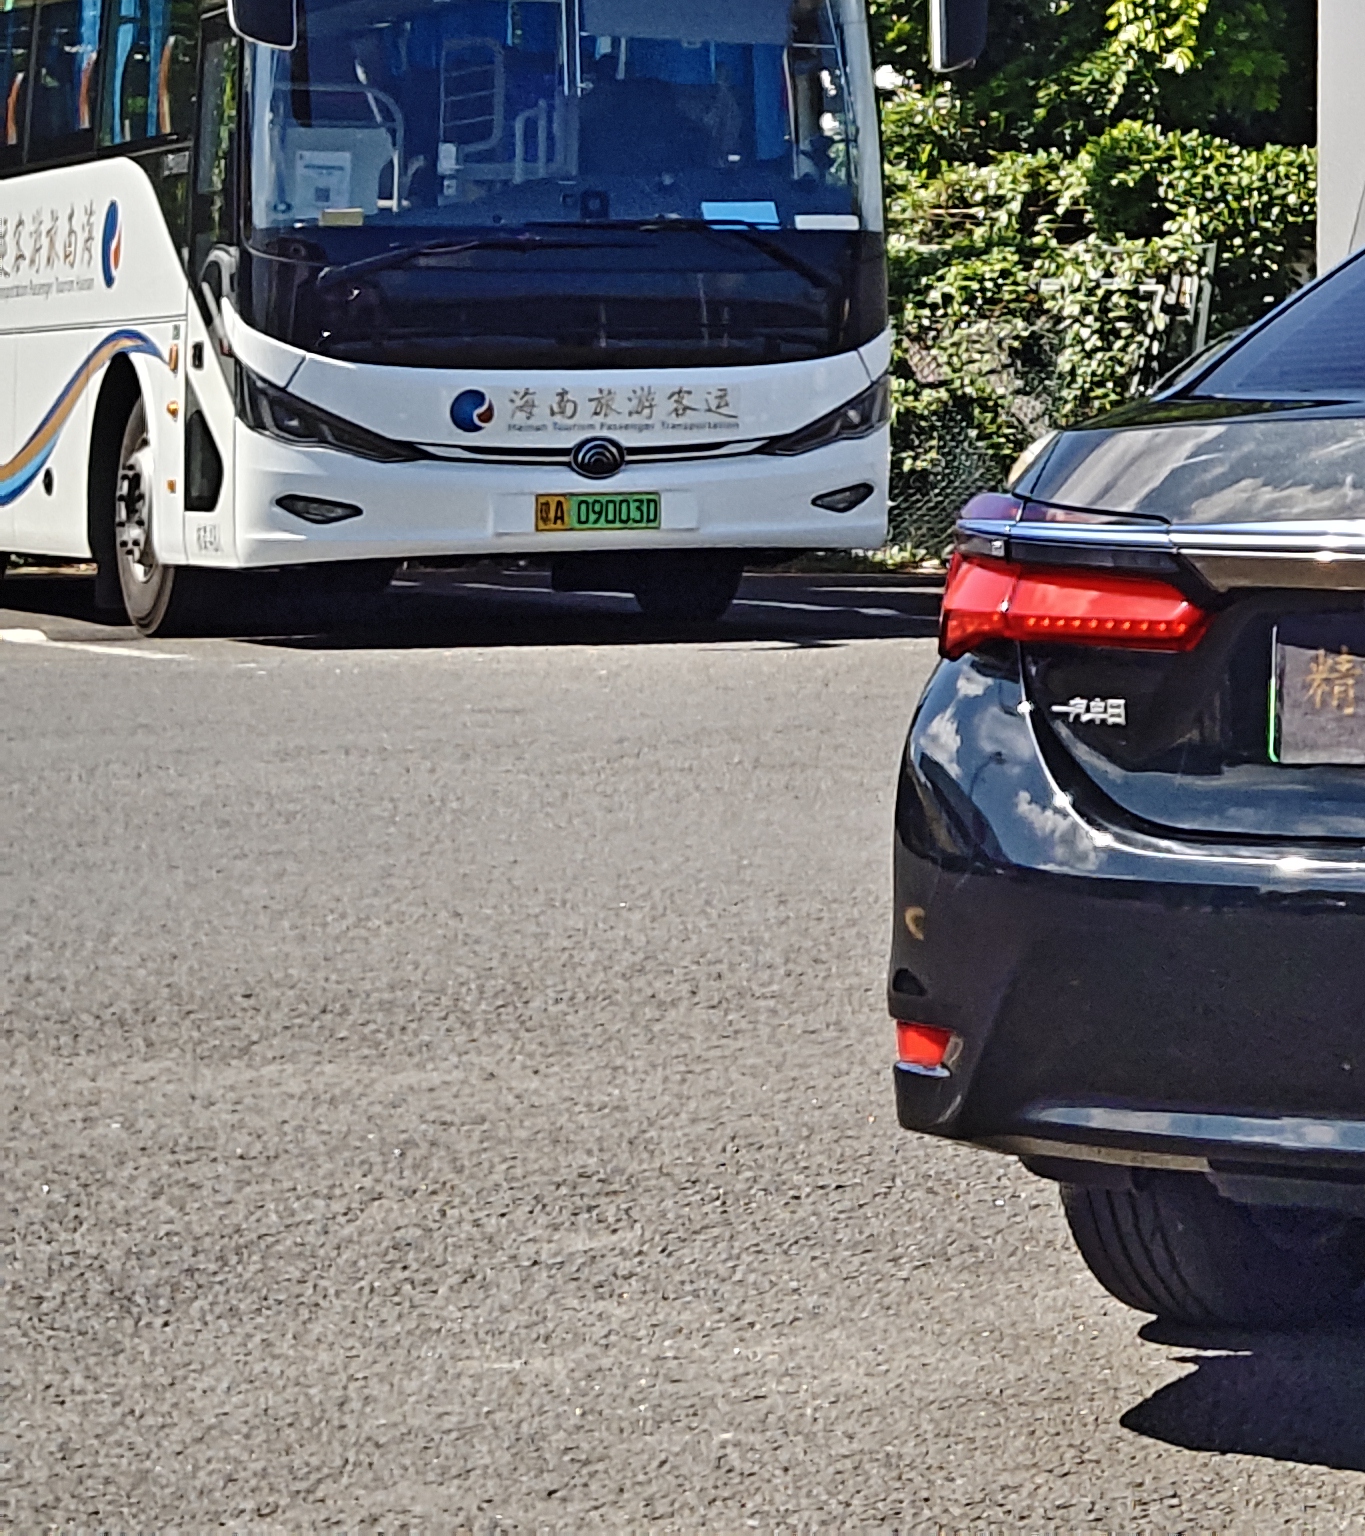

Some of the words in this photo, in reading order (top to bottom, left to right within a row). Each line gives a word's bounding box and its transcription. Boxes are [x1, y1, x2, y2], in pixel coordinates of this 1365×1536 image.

[508, 386, 739, 420] 海南旅游客运
